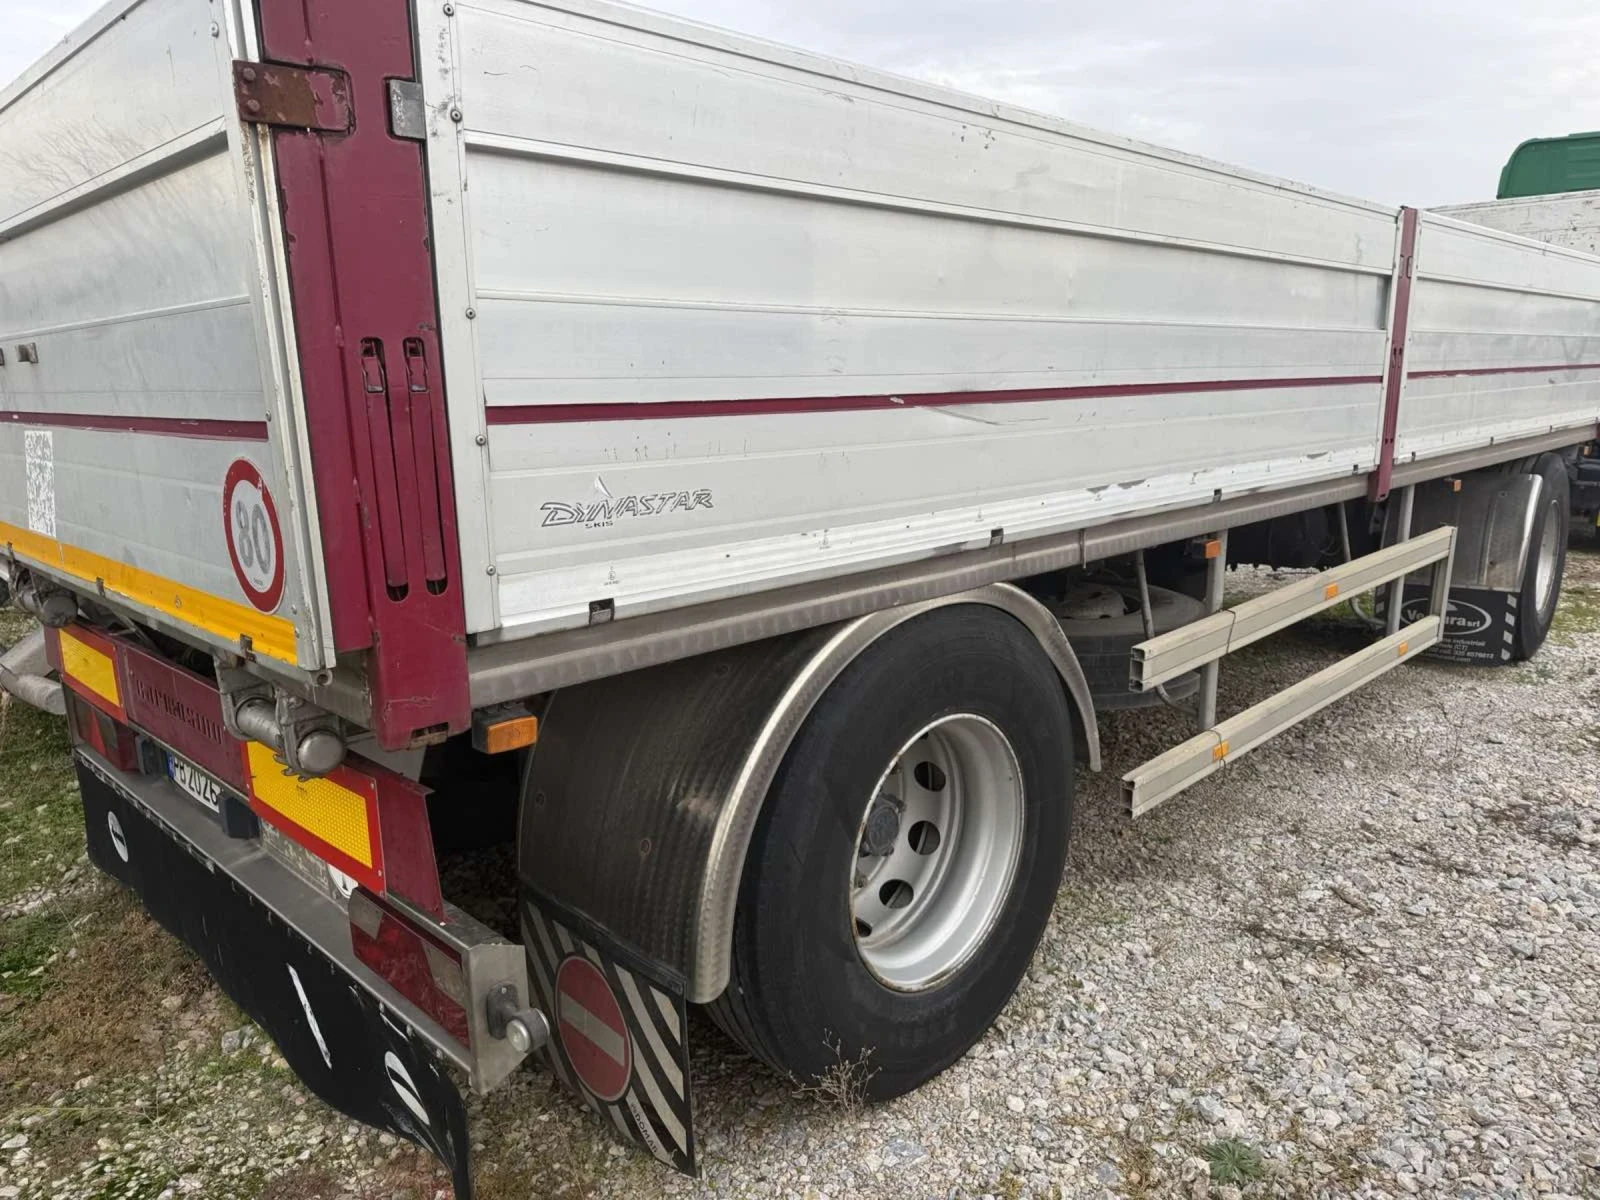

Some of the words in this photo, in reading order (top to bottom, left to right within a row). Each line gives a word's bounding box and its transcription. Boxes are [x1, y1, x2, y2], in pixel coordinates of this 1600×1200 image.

[540, 489, 714, 527] DYNASTAR
[585, 521, 614, 529] SKIS
[235, 500, 271, 574] 80
[1467, 620, 1480, 628] srl
